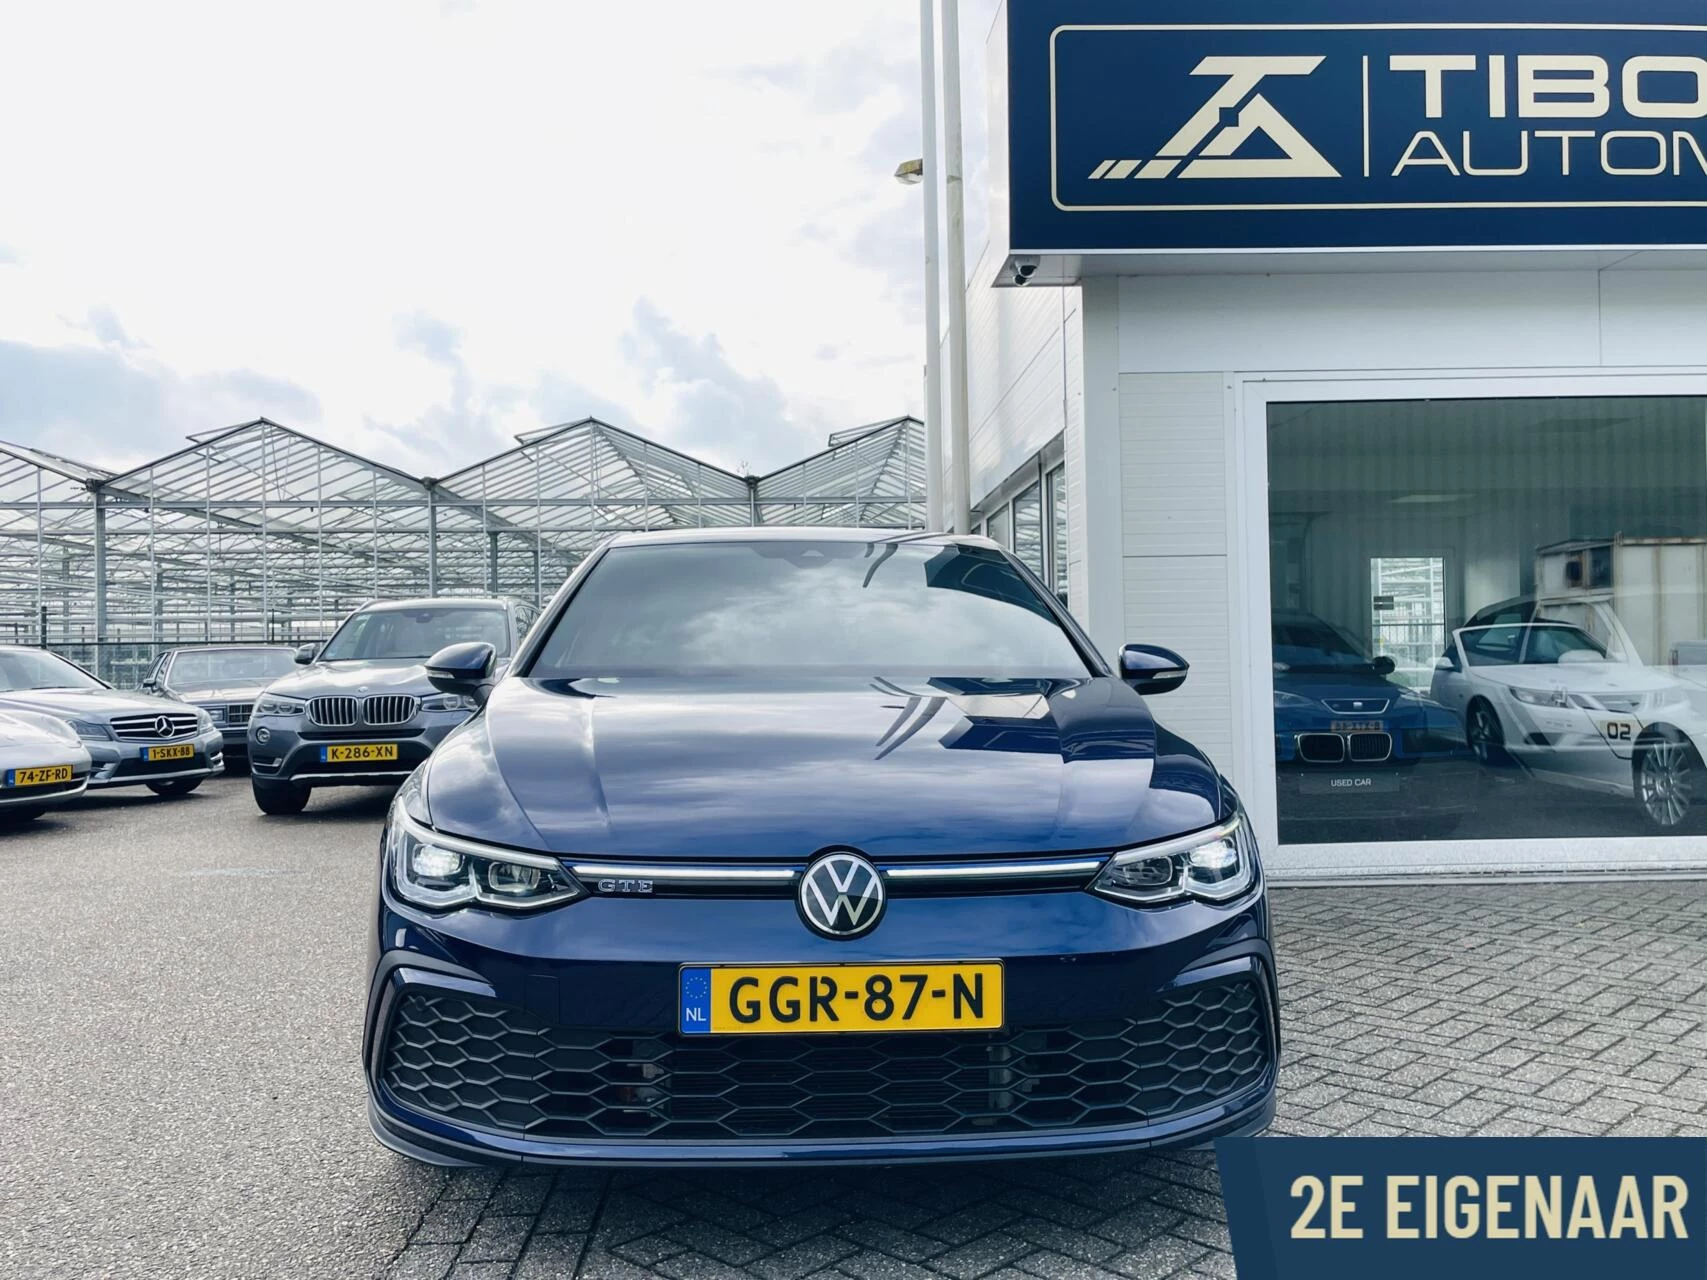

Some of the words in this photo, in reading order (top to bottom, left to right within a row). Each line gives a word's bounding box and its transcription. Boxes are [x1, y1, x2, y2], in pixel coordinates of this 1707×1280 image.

[1389, 55, 1707, 118] TIBO
[331, 746, 393, 760] K-286-XN
[20, 767, 67, 783] 74-ZF-RD
[1331, 779, 1353, 787] USED
[1354, 778, 1371, 786] CAR
[598, 878, 653, 893] GTE
[685, 1007, 707, 1022] NL
[729, 973, 984, 1024] GGR-87-N
